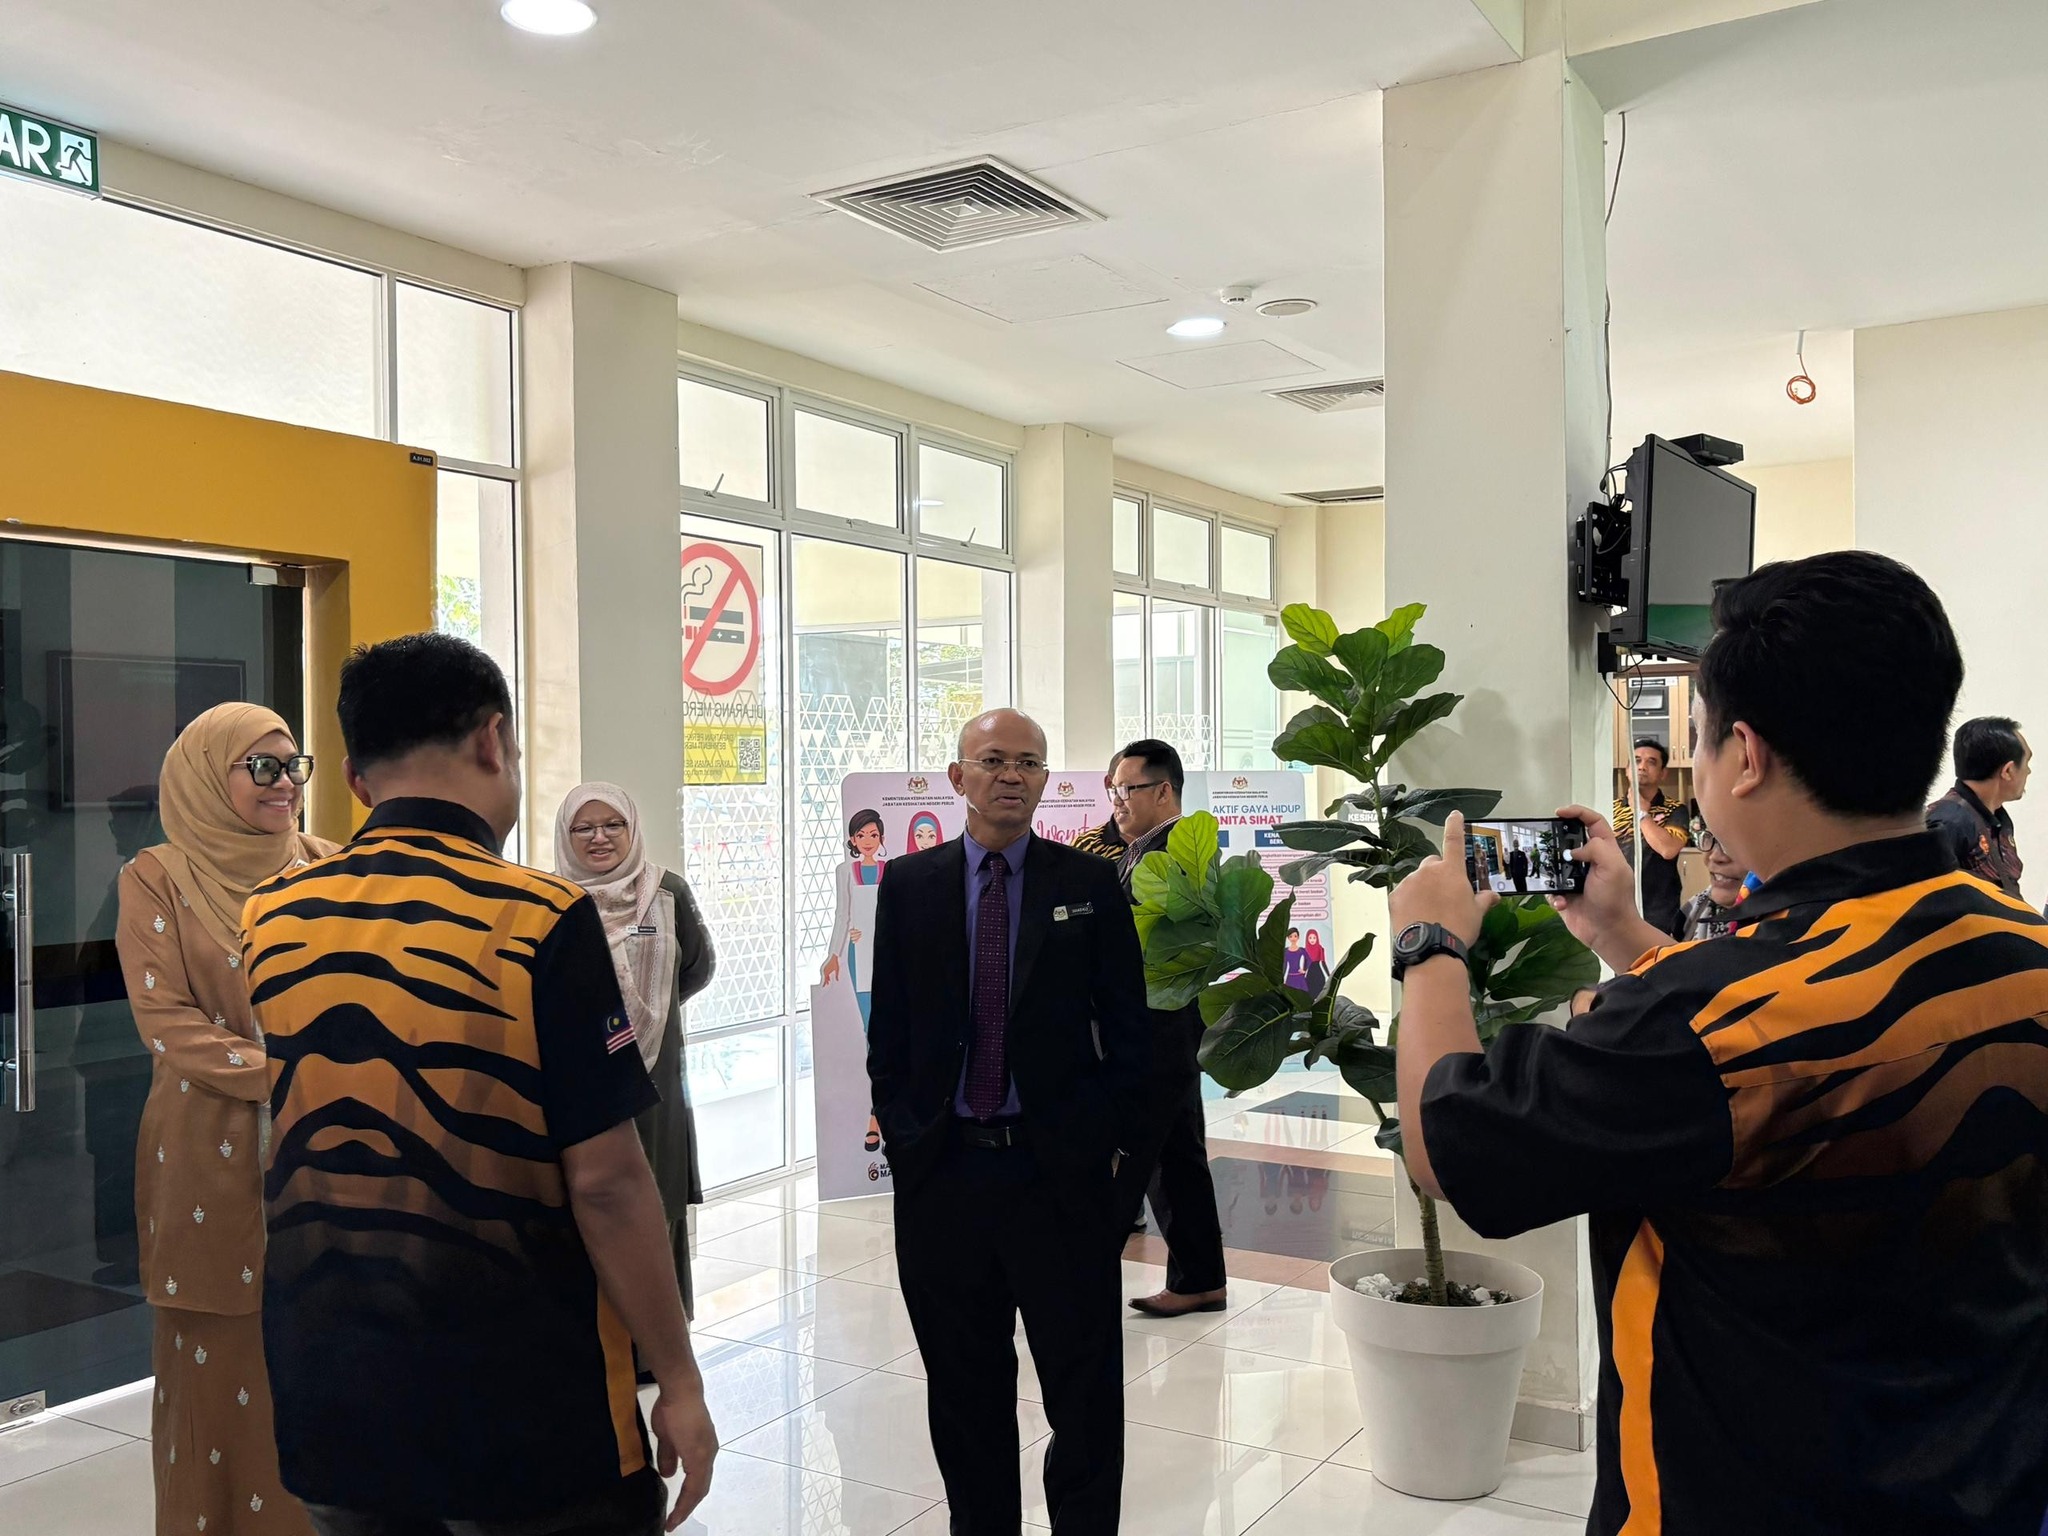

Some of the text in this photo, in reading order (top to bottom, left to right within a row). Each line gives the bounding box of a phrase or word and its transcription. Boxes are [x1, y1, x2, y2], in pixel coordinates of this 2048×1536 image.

[0, 113, 52, 176] AR
[1212, 804, 1301, 814] AKTIF GAYA HIDUP
[1249, 815, 1283, 825] SIHAT
